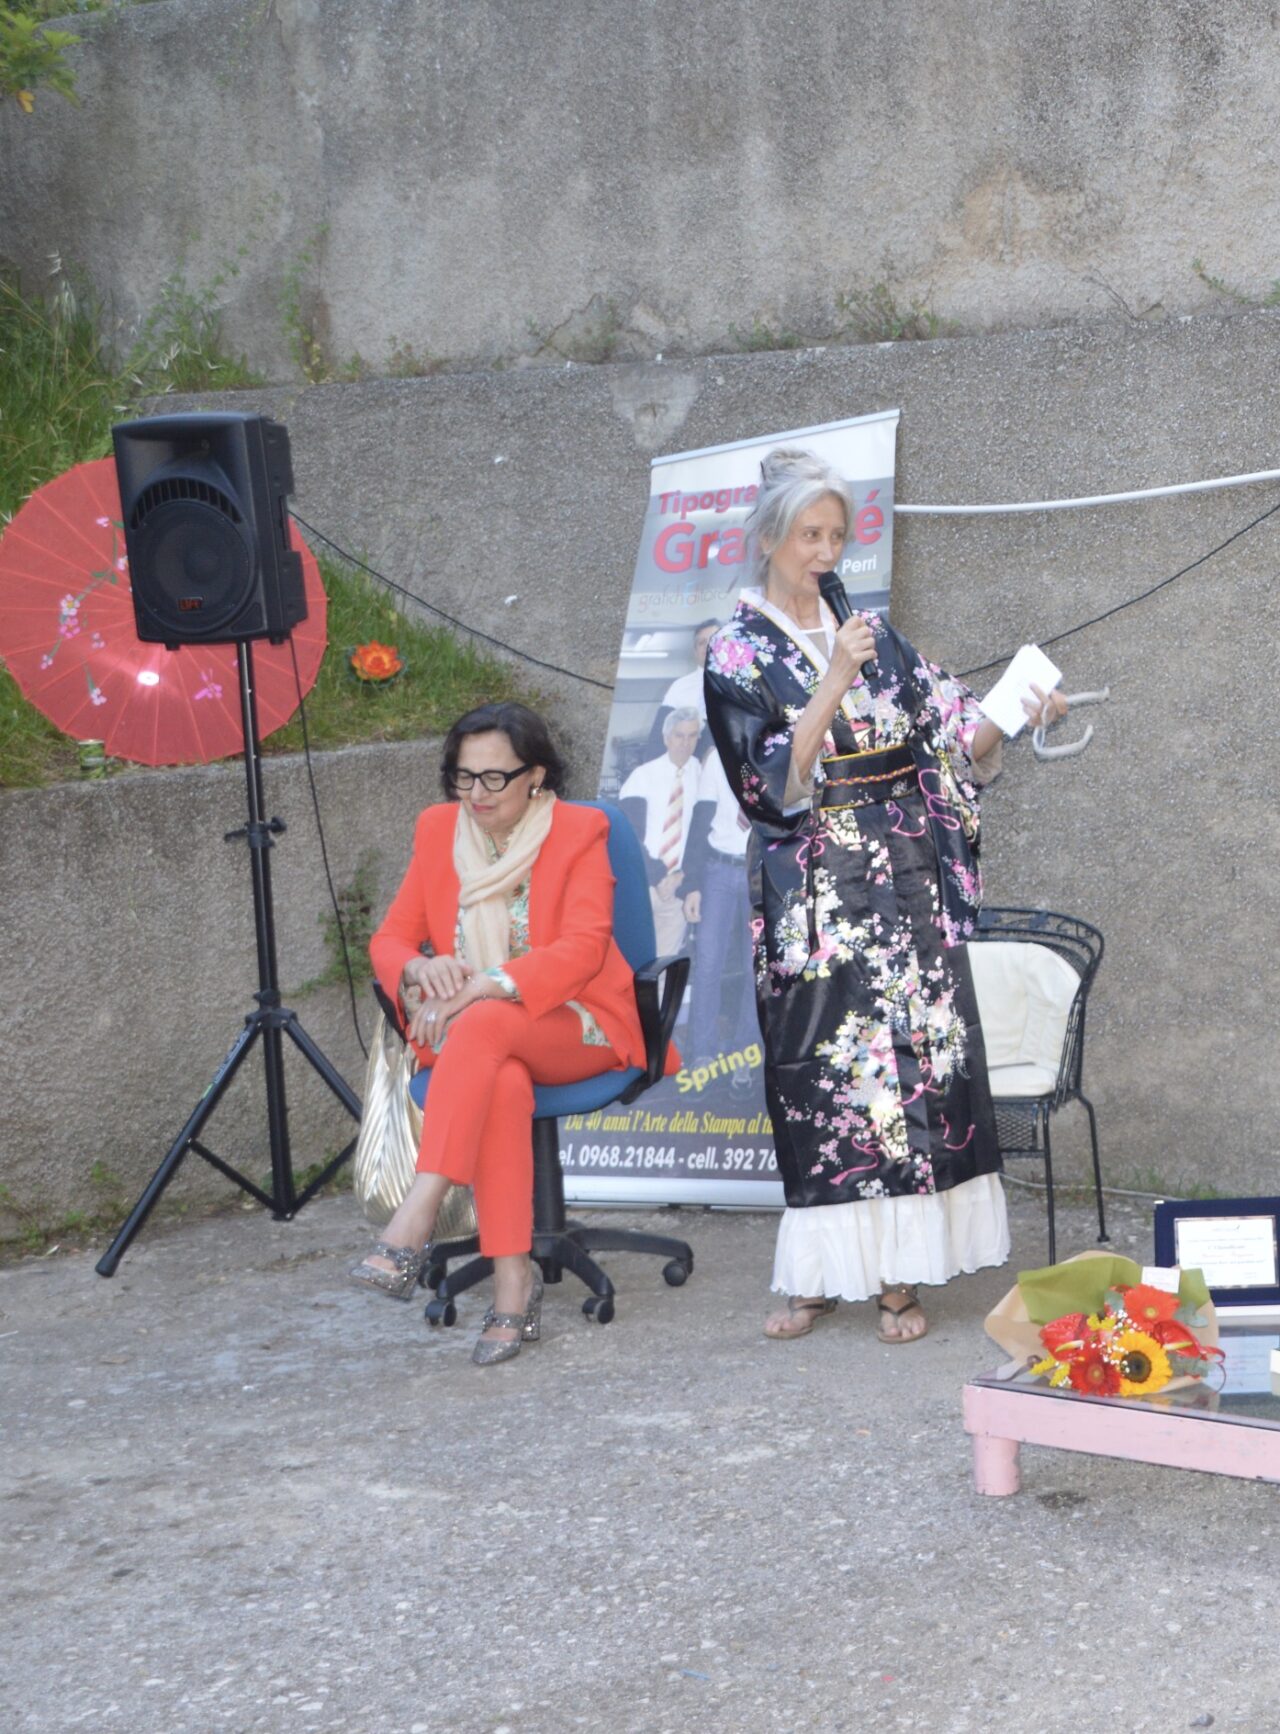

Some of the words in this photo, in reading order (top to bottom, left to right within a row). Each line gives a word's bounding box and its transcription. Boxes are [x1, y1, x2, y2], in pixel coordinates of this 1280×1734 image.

[660, 484, 757, 519] Tipogra
[842, 555, 877, 574] Perri
[676, 1043, 762, 1093] Spring
[586, 1111, 602, 1131] 40
[603, 1113, 630, 1132] anni
[668, 1113, 698, 1133] della
[701, 1115, 746, 1139] Stampa
[748, 1114, 762, 1133] al
[763, 1117, 775, 1133] tu
[559, 1143, 575, 1166] el.
[579, 1146, 676, 1169] 0968.21844
[687, 1149, 719, 1170] cell.
[722, 1149, 755, 1171] 392
[757, 1150, 778, 1172] 76
